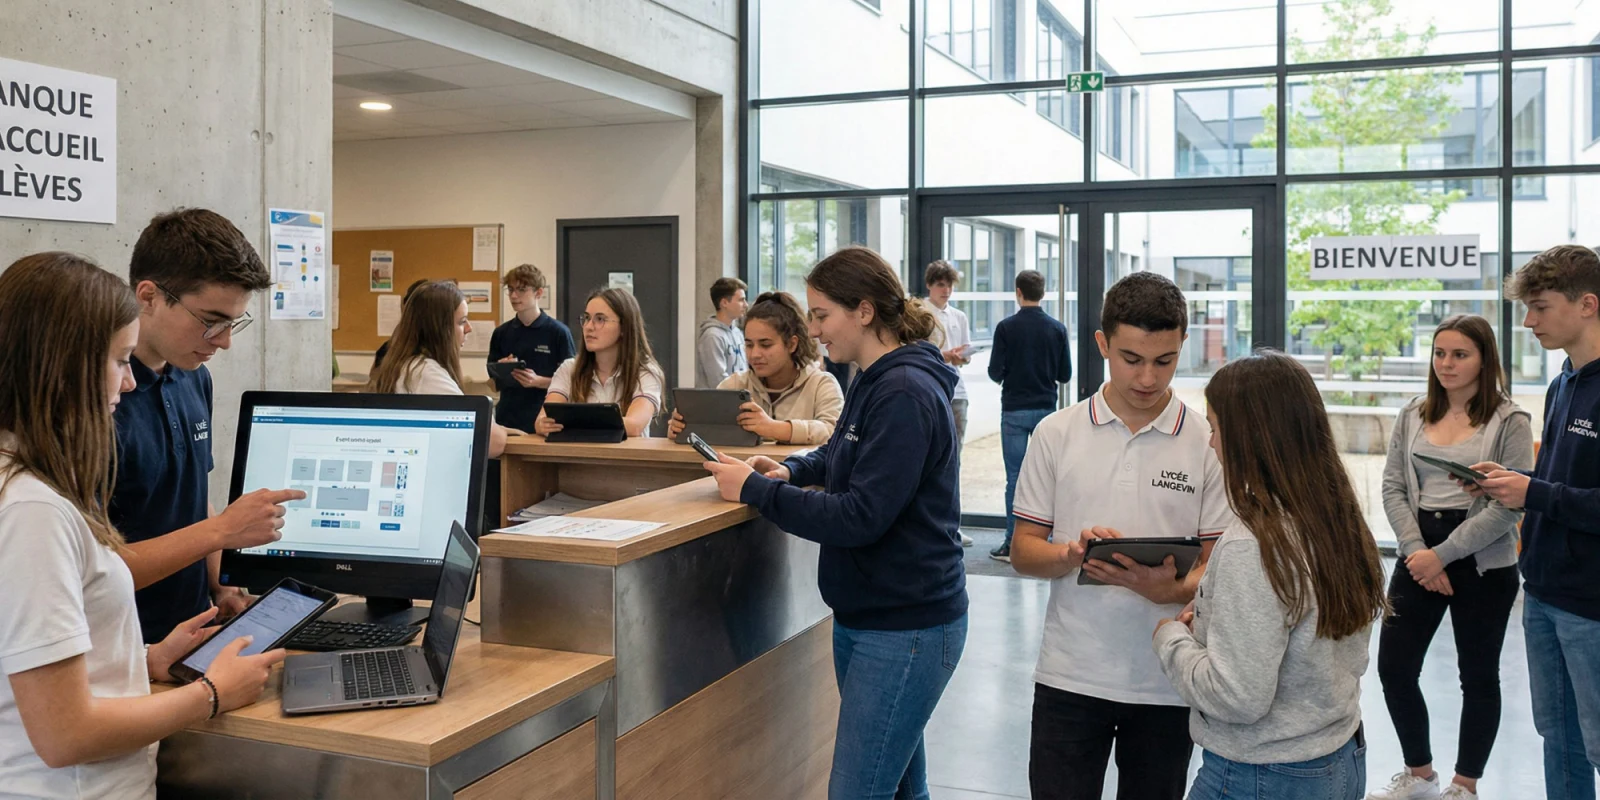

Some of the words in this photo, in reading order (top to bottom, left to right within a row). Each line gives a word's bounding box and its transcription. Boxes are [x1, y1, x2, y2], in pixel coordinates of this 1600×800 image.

[0, 126, 104, 162] CCUEIL
[1314, 245, 1477, 269] BIENVENUE
[1151, 478, 1196, 494] LANGEVIN
[1160, 469, 1189, 483] LYCÉE
